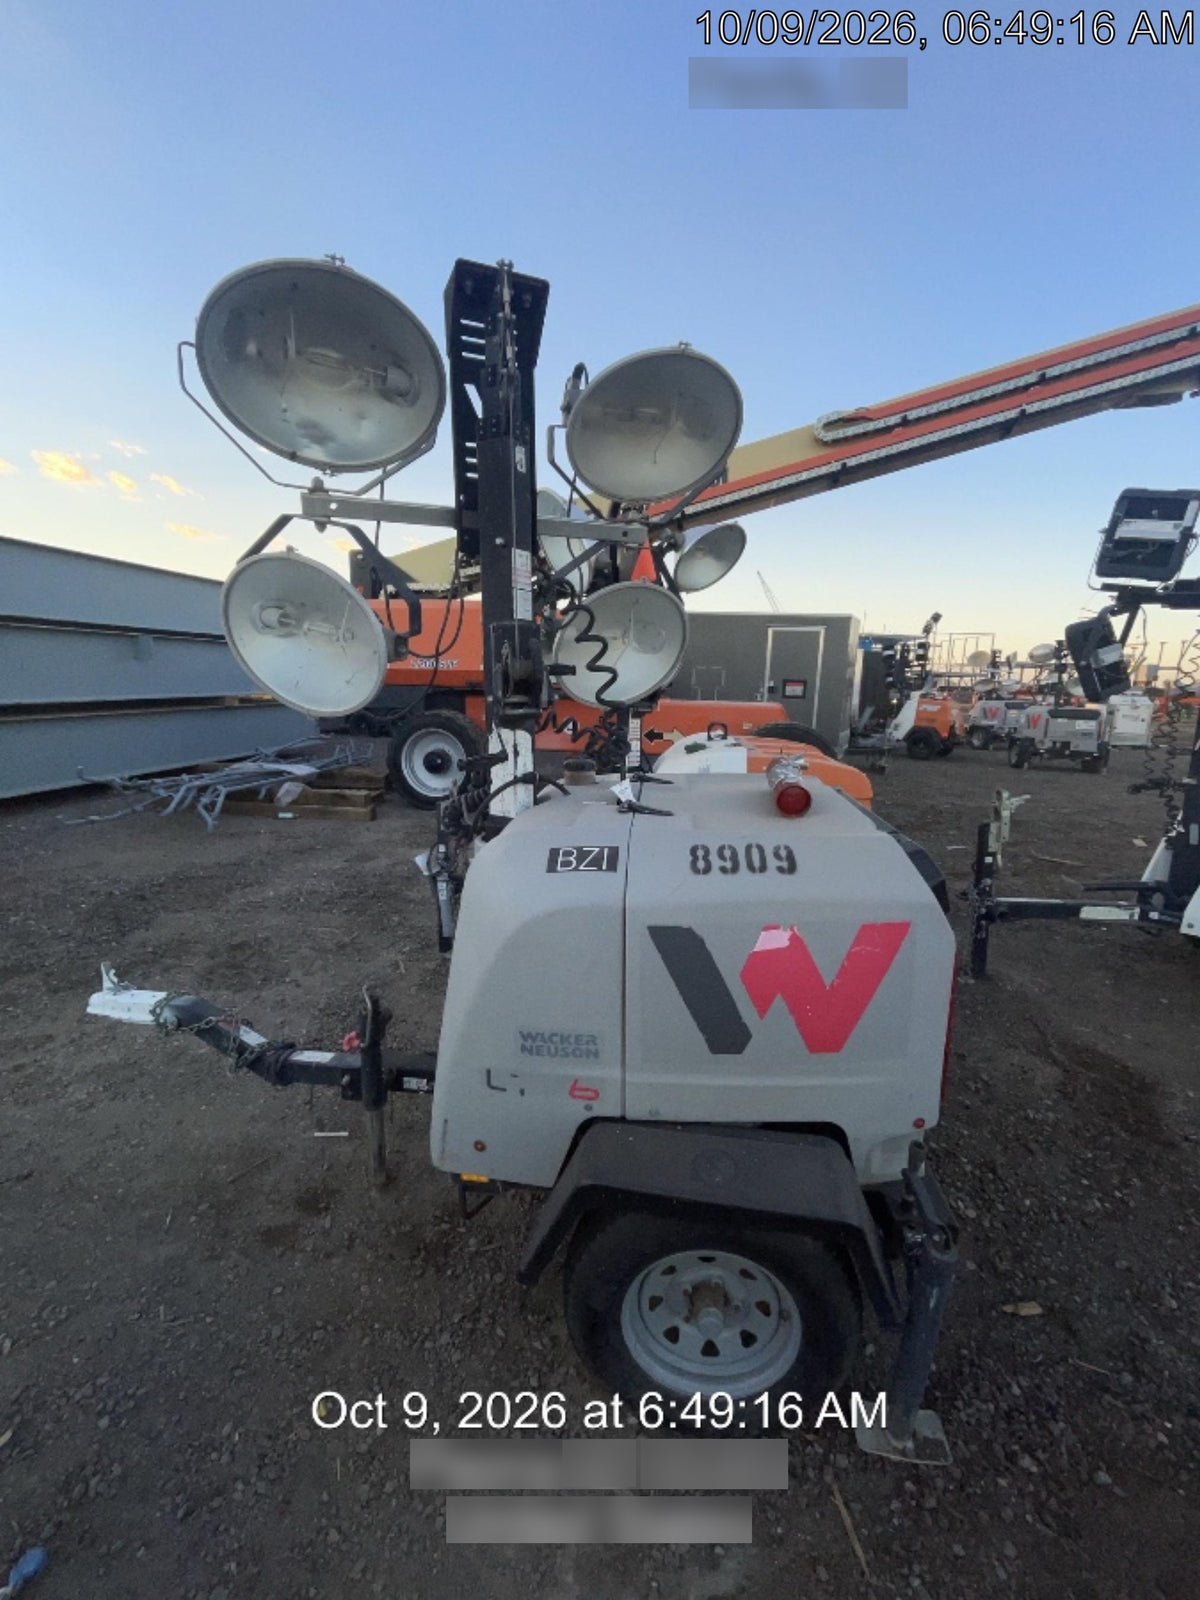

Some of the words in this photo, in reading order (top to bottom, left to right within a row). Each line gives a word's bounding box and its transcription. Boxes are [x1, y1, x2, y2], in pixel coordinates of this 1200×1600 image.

[556, 847, 609, 871] BZI
[689, 843, 798, 875] 8909
[519, 1030, 598, 1046] WACKER
[520, 1043, 600, 1059] NEUSON
